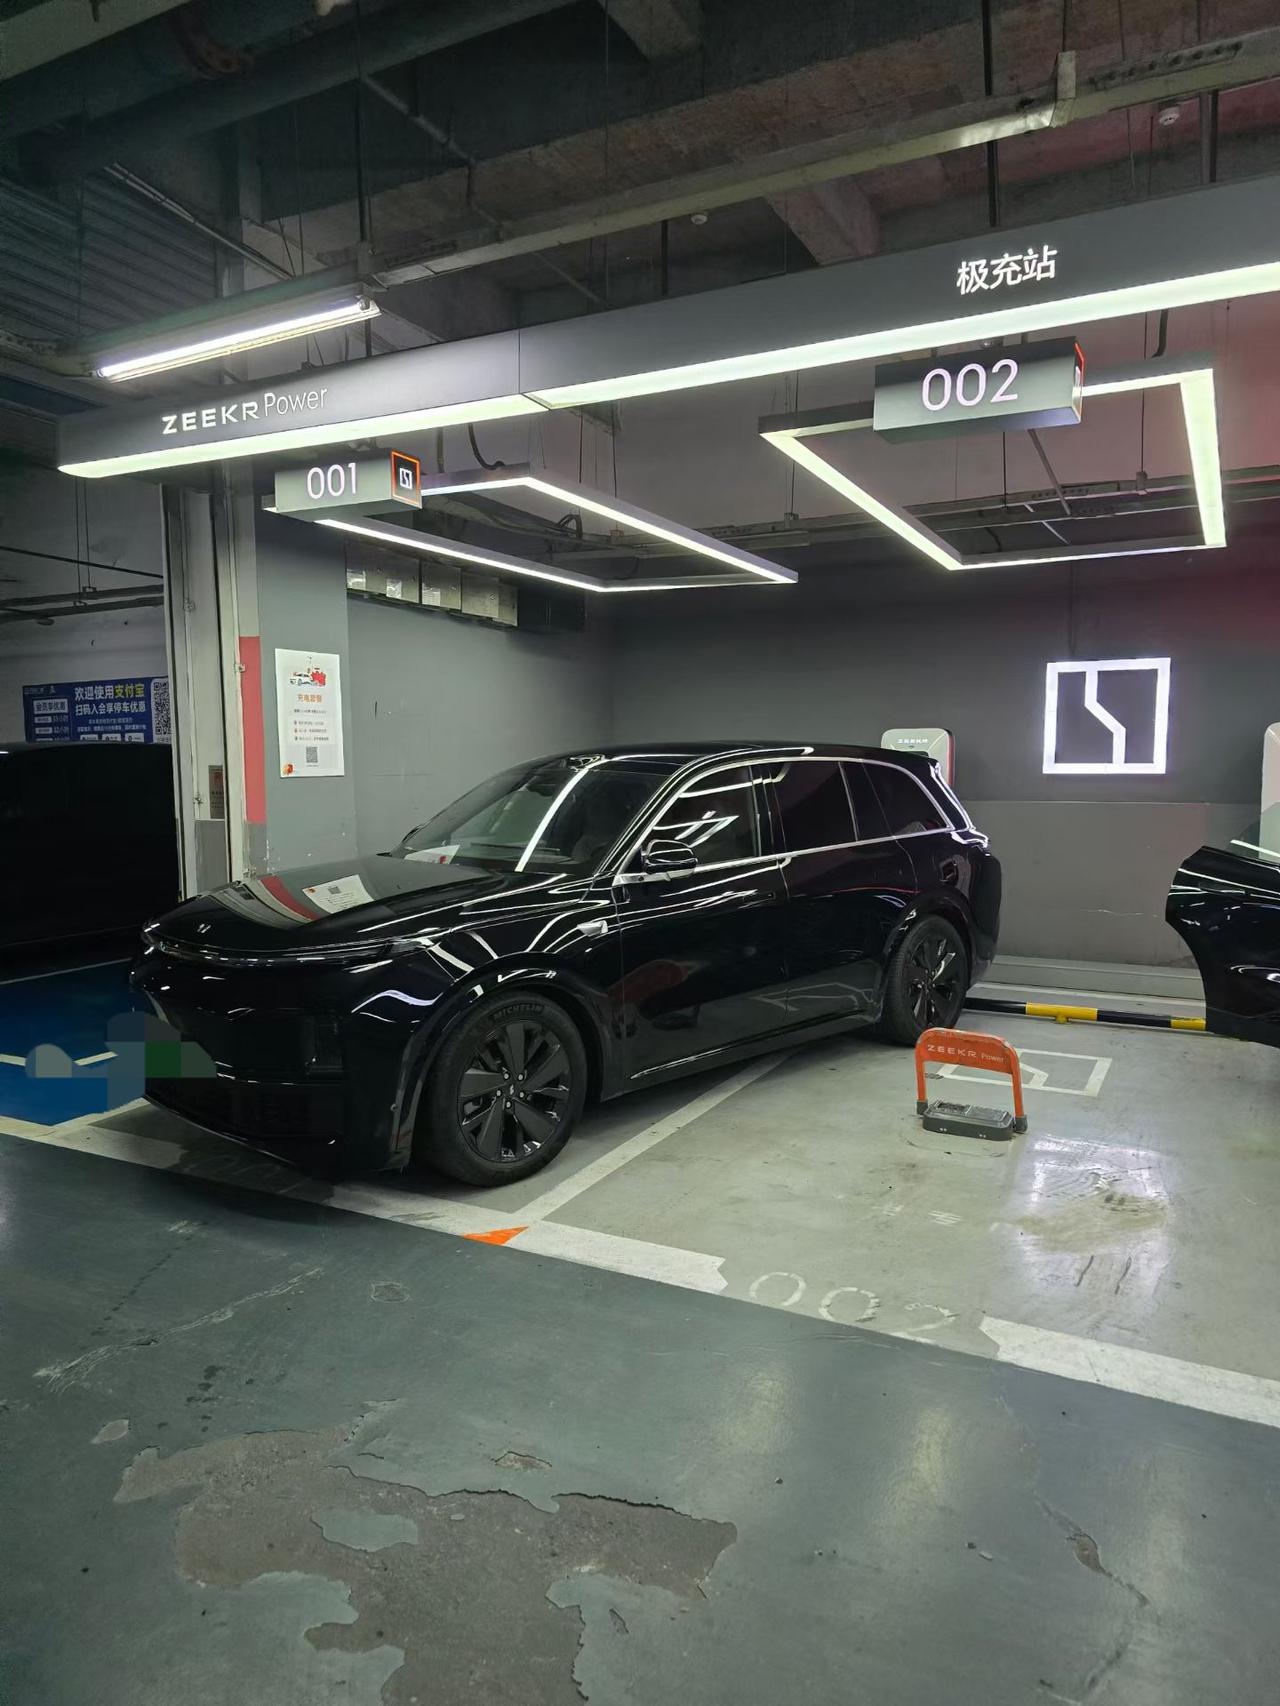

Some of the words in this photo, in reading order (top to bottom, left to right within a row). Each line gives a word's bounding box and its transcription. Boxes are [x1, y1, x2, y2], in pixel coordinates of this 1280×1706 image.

[956, 245, 1058, 295] 极充站
[922, 358, 1019, 412] 002
[161, 401, 260, 435] ZEEKR
[263, 387, 328, 417] Power
[306, 462, 357, 500] 001
[74, 683, 145, 702] 欢迎使用支付宝
[75, 701, 146, 716] 扫码入会享停车优惠
[927, 1044, 977, 1058] ZEEKR
[981, 1052, 1004, 1063] Power
